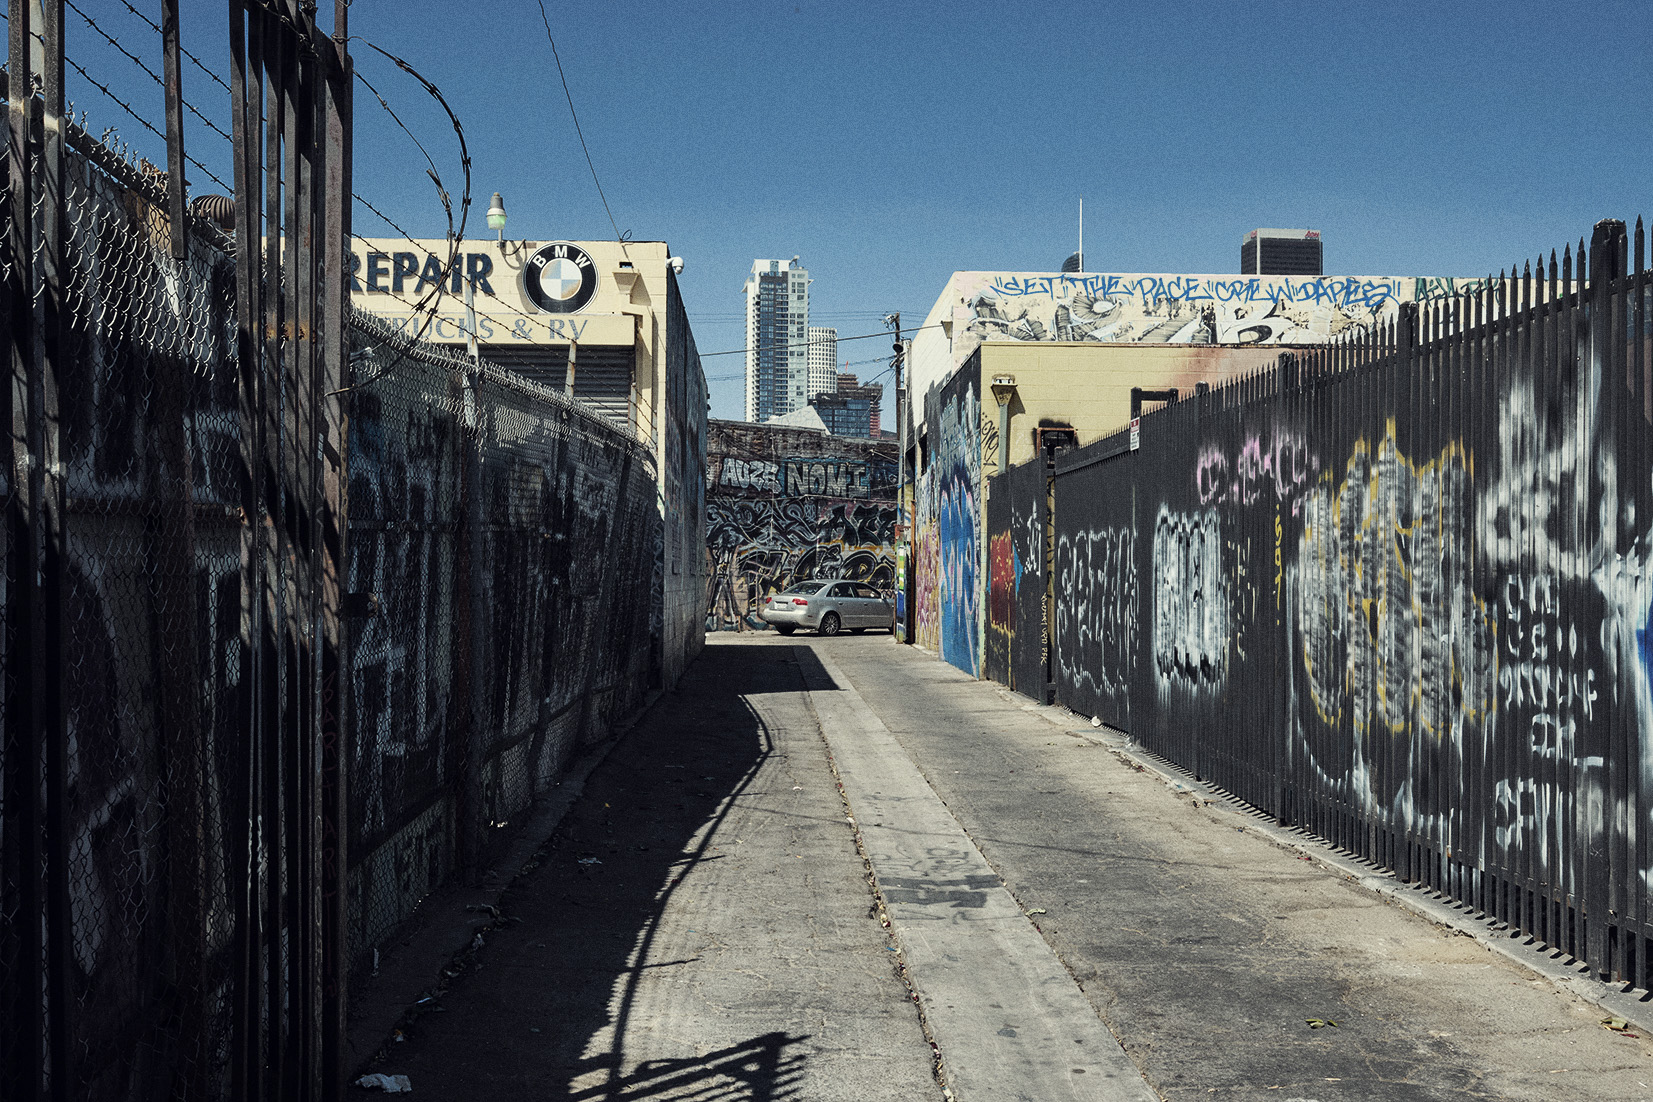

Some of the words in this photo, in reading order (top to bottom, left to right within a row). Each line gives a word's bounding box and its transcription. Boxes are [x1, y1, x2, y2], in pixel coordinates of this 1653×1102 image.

[532, 245, 591, 268] BMW
[351, 252, 494, 294] REPAIR
[511, 318, 533, 340] &
[550, 318, 588, 340] RV
